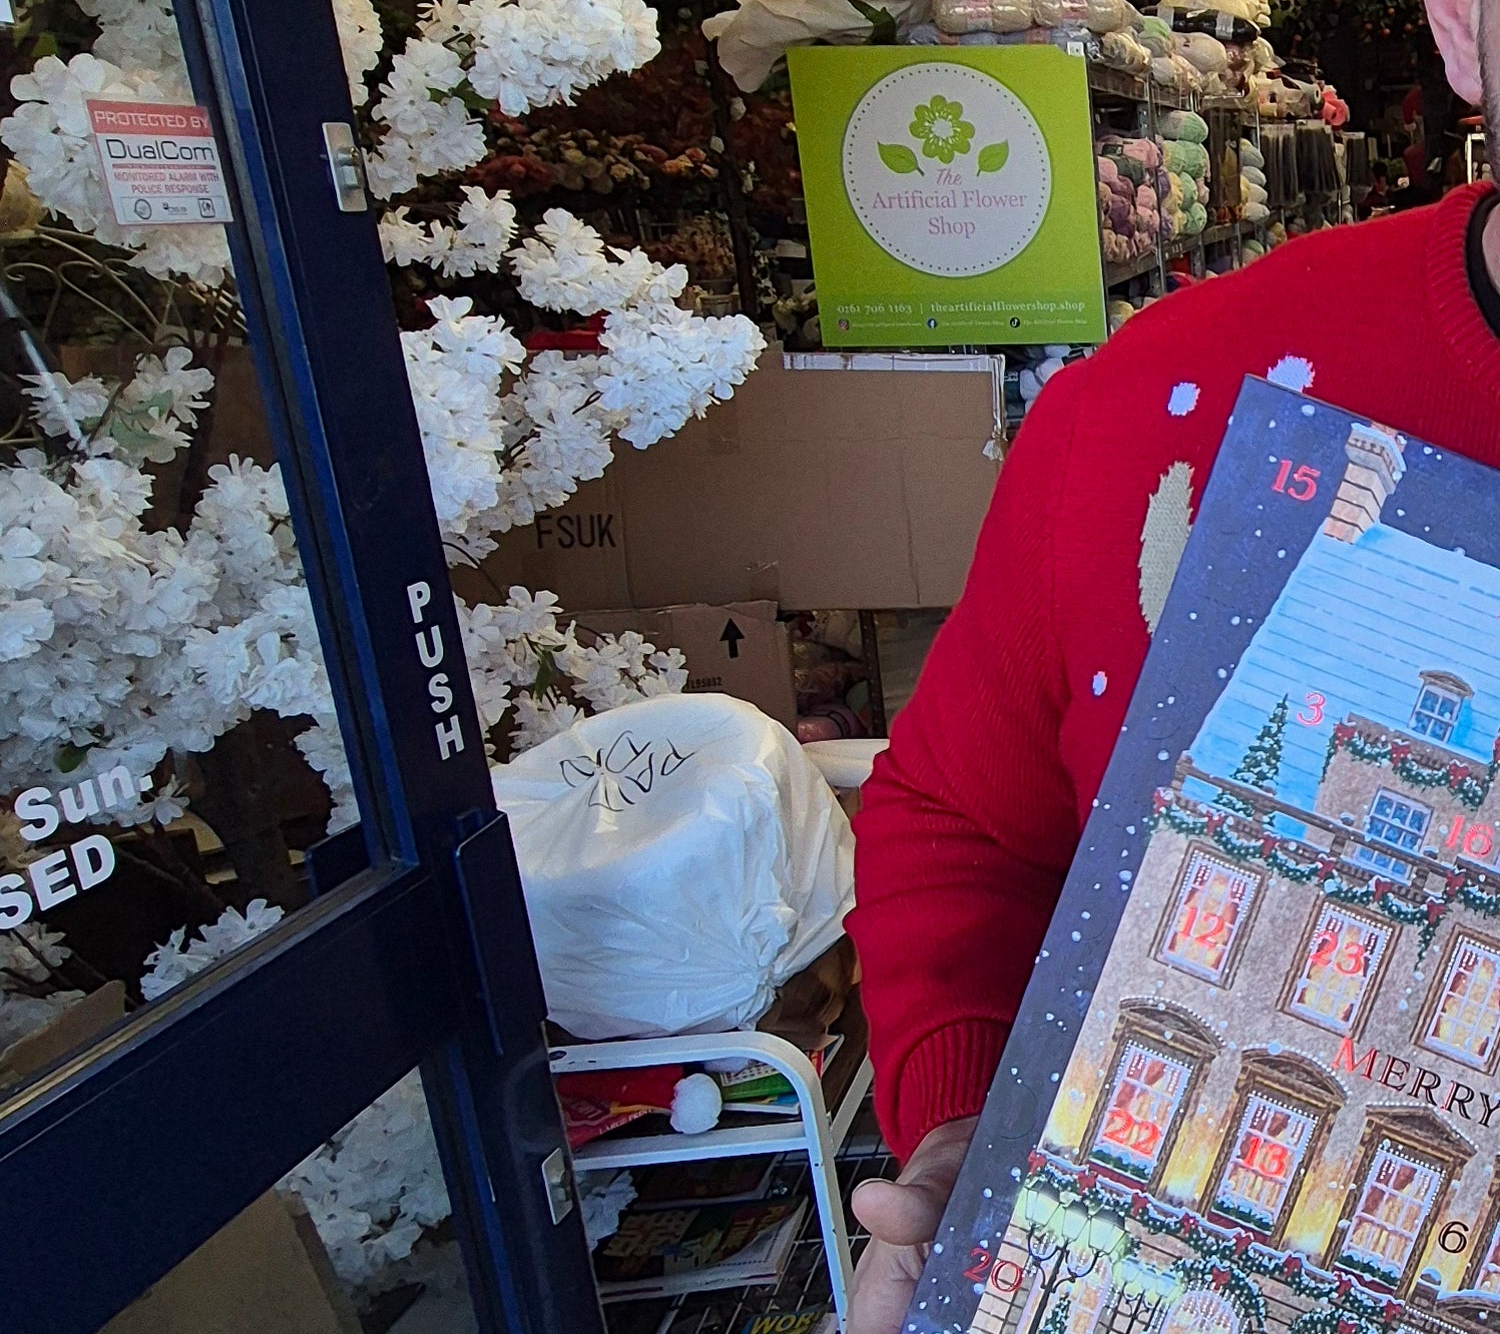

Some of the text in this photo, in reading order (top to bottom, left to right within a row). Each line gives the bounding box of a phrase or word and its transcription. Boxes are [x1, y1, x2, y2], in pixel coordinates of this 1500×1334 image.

[93, 110, 209, 129] PROTECTED BY
[105, 138, 215, 161] DualCom
[131, 183, 210, 195] POLICE RESPONSE
[169, 172, 198, 182] ALARM
[936, 168, 963, 187] The
[872, 189, 1028, 209] Artificial Flower
[928, 217, 977, 239] Shop
[837, 303, 861, 314] 0161
[865, 304, 885, 315] 706
[1270, 460, 1321, 502] 15
[535, 514, 616, 548] FSUK
[406, 581, 465, 761] PUSH
[1297, 692, 1327, 726] 3
[14, 765, 154, 842] Sun.
[1444, 815, 1494, 859] 16
[1177, 907, 1226, 949] 12
[1309, 930, 1366, 977] 23
[1102, 1108, 1162, 1160] 22
[1241, 1135, 1290, 1179] 13
[1437, 1220, 1470, 1255] 6
[962, 1247, 1024, 1293] 20
